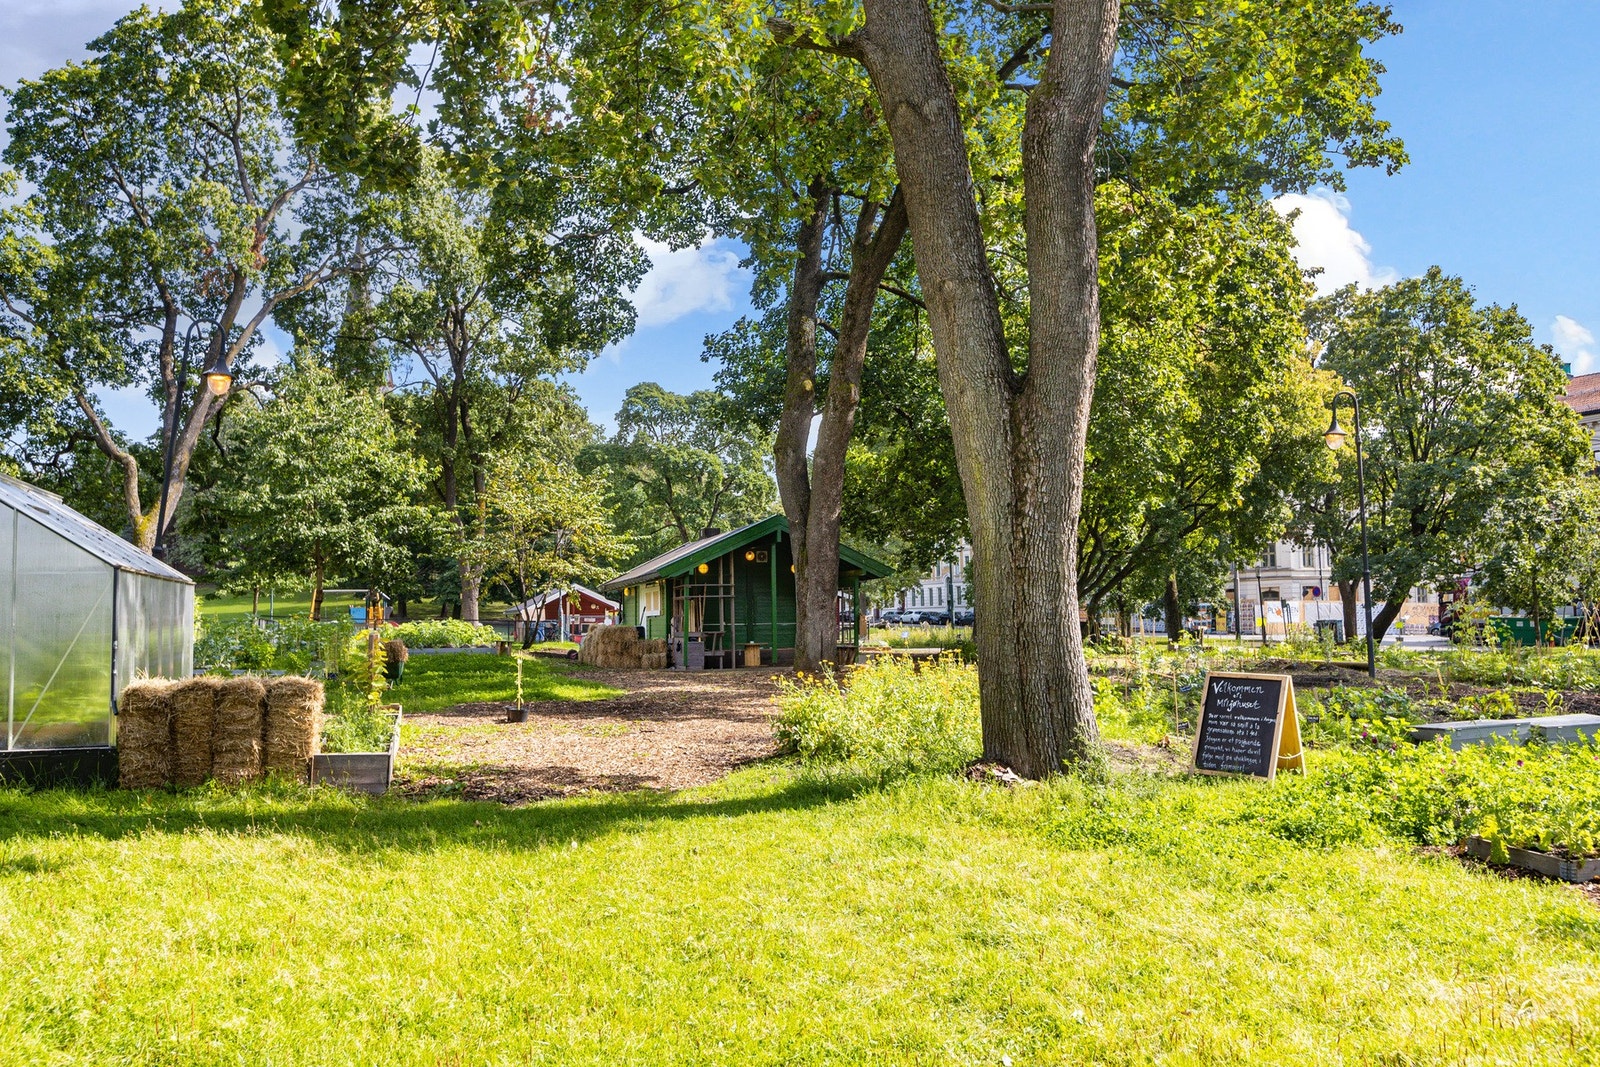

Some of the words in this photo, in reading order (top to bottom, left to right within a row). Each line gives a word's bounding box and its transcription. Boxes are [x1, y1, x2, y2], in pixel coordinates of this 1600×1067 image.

[1212, 680, 1264, 694] Velkommen
[1216, 698, 1261, 712] Miljøhuset
[1205, 735, 1221, 744] Hagen
